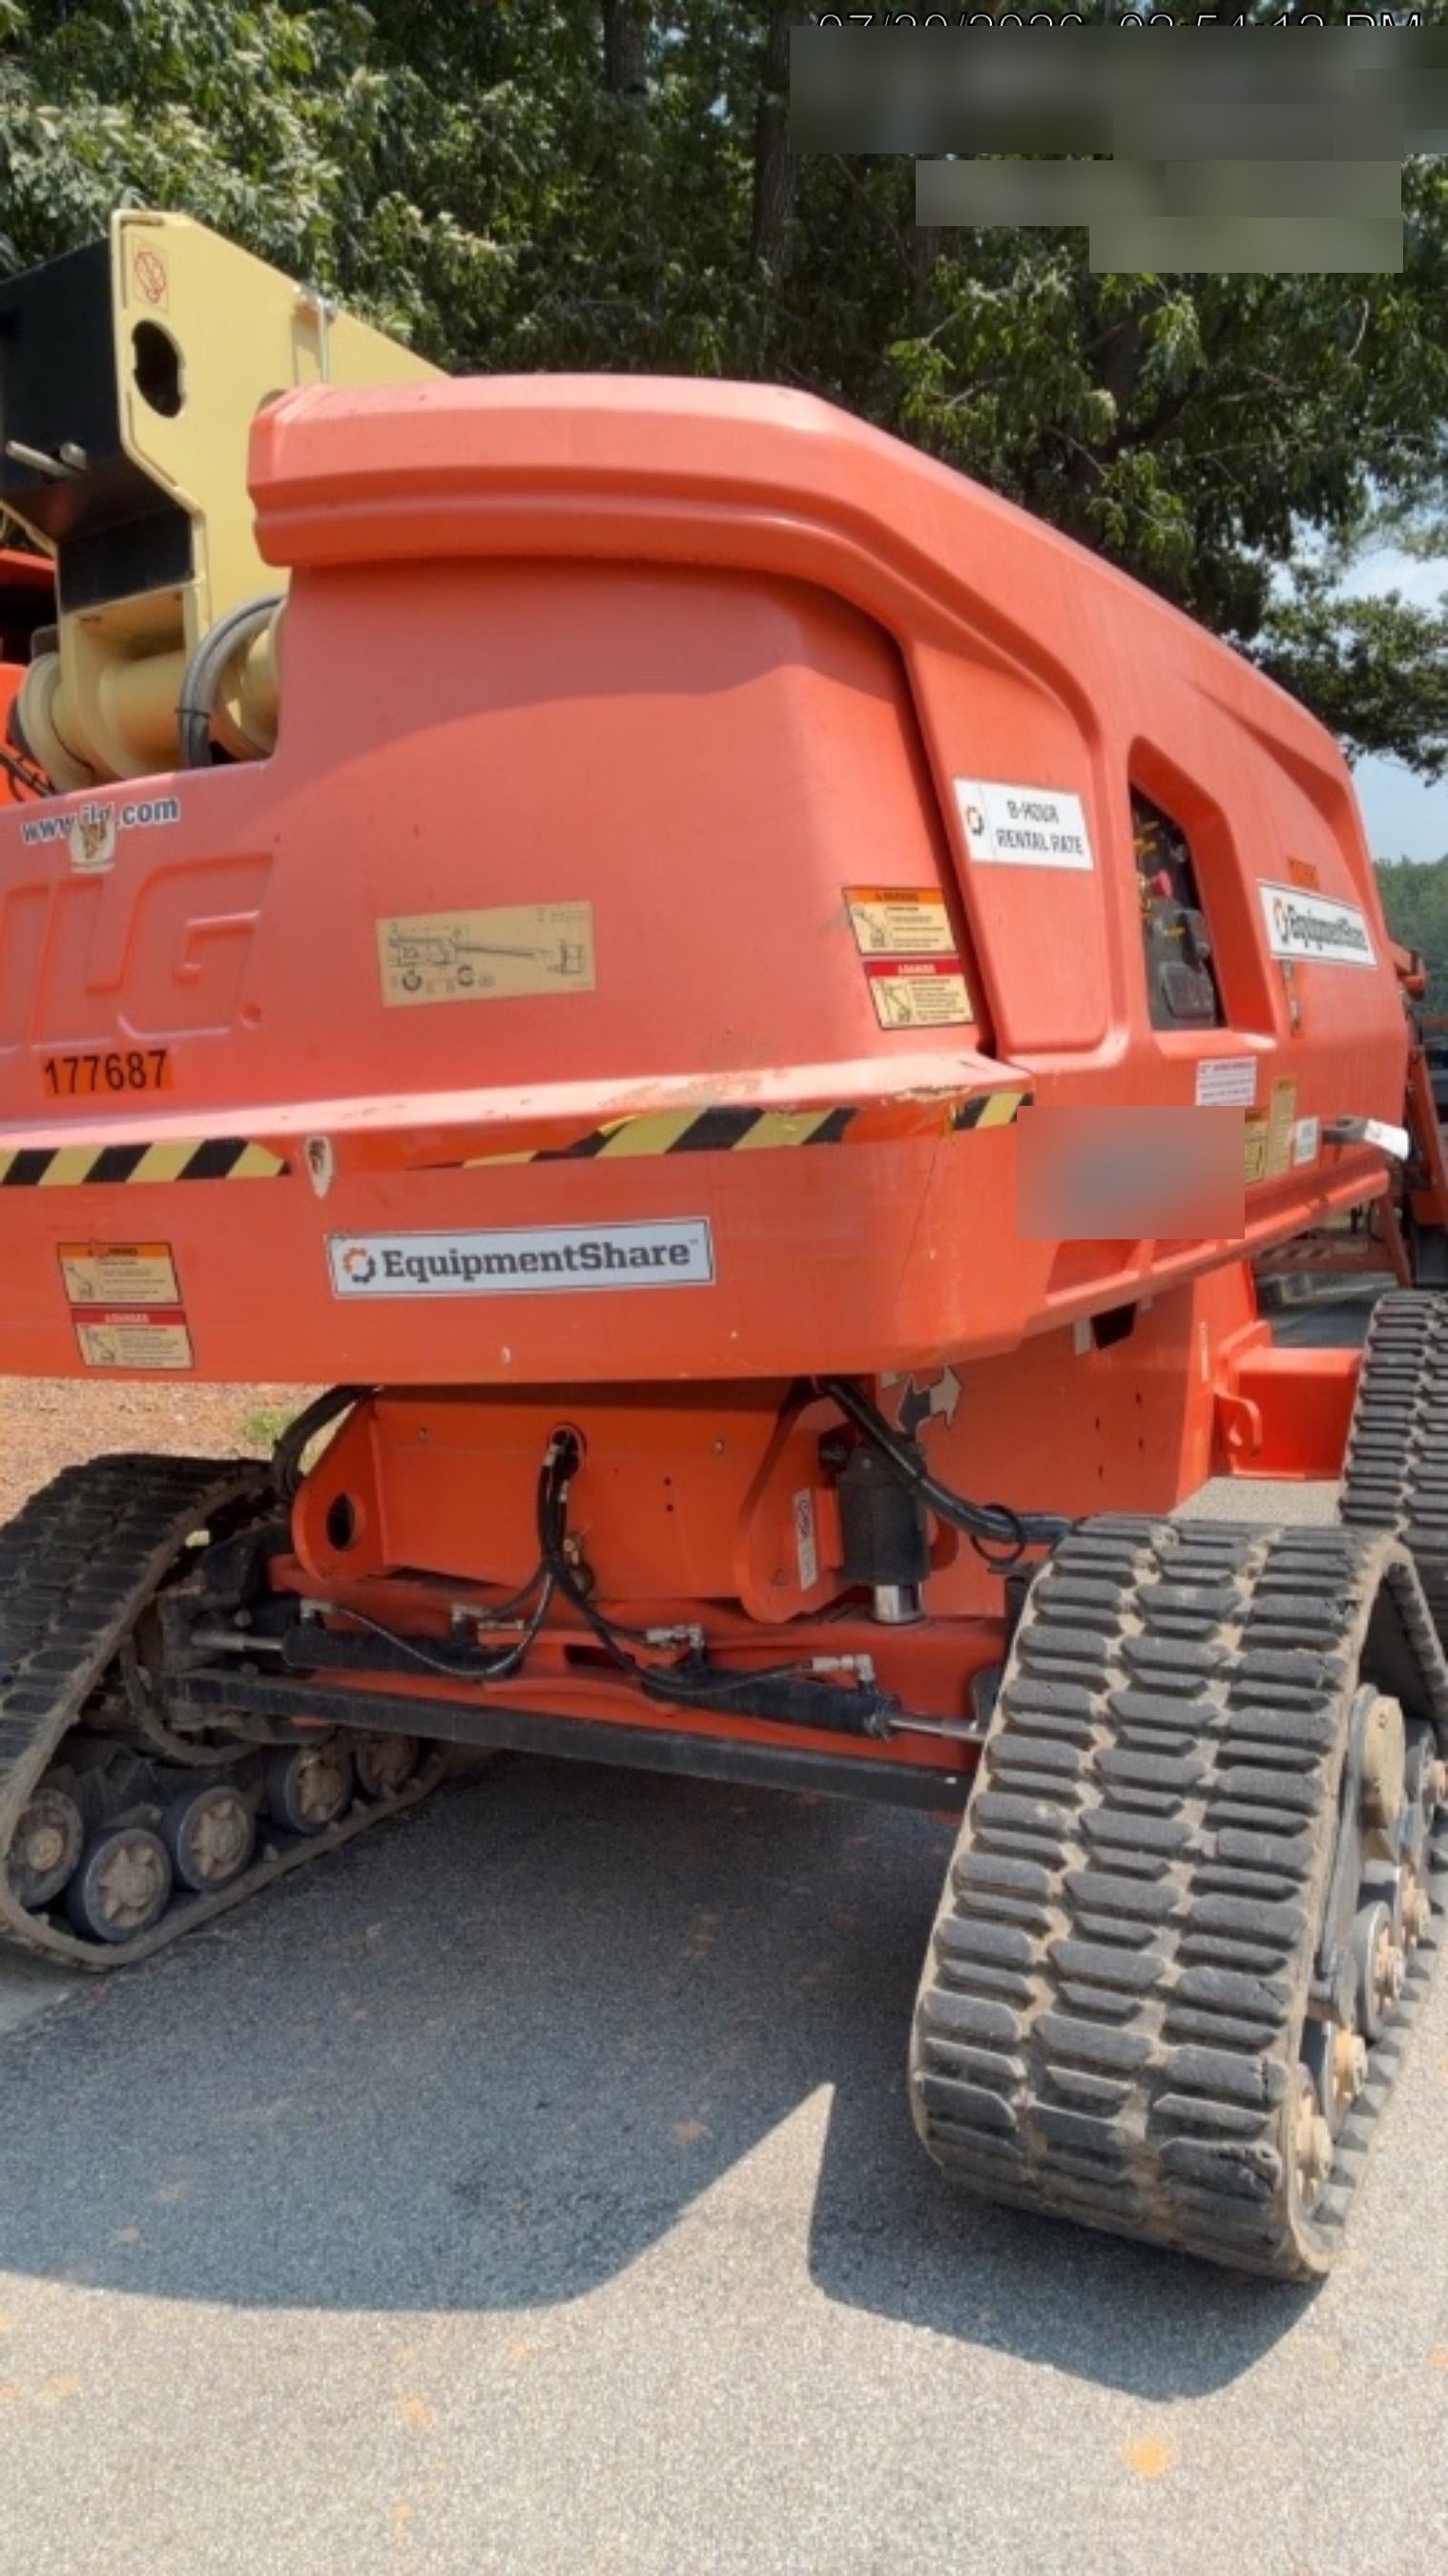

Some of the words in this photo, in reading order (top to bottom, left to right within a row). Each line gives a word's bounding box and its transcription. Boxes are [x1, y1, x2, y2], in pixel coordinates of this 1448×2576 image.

[22, 799, 180, 843] wwwjlg.com
[996, 827, 1050, 852] RENTAL
[1050, 834, 1085, 856] RATE
[45, 1049, 167, 1095] 177687
[382, 1241, 692, 1283] EquipmentShare
